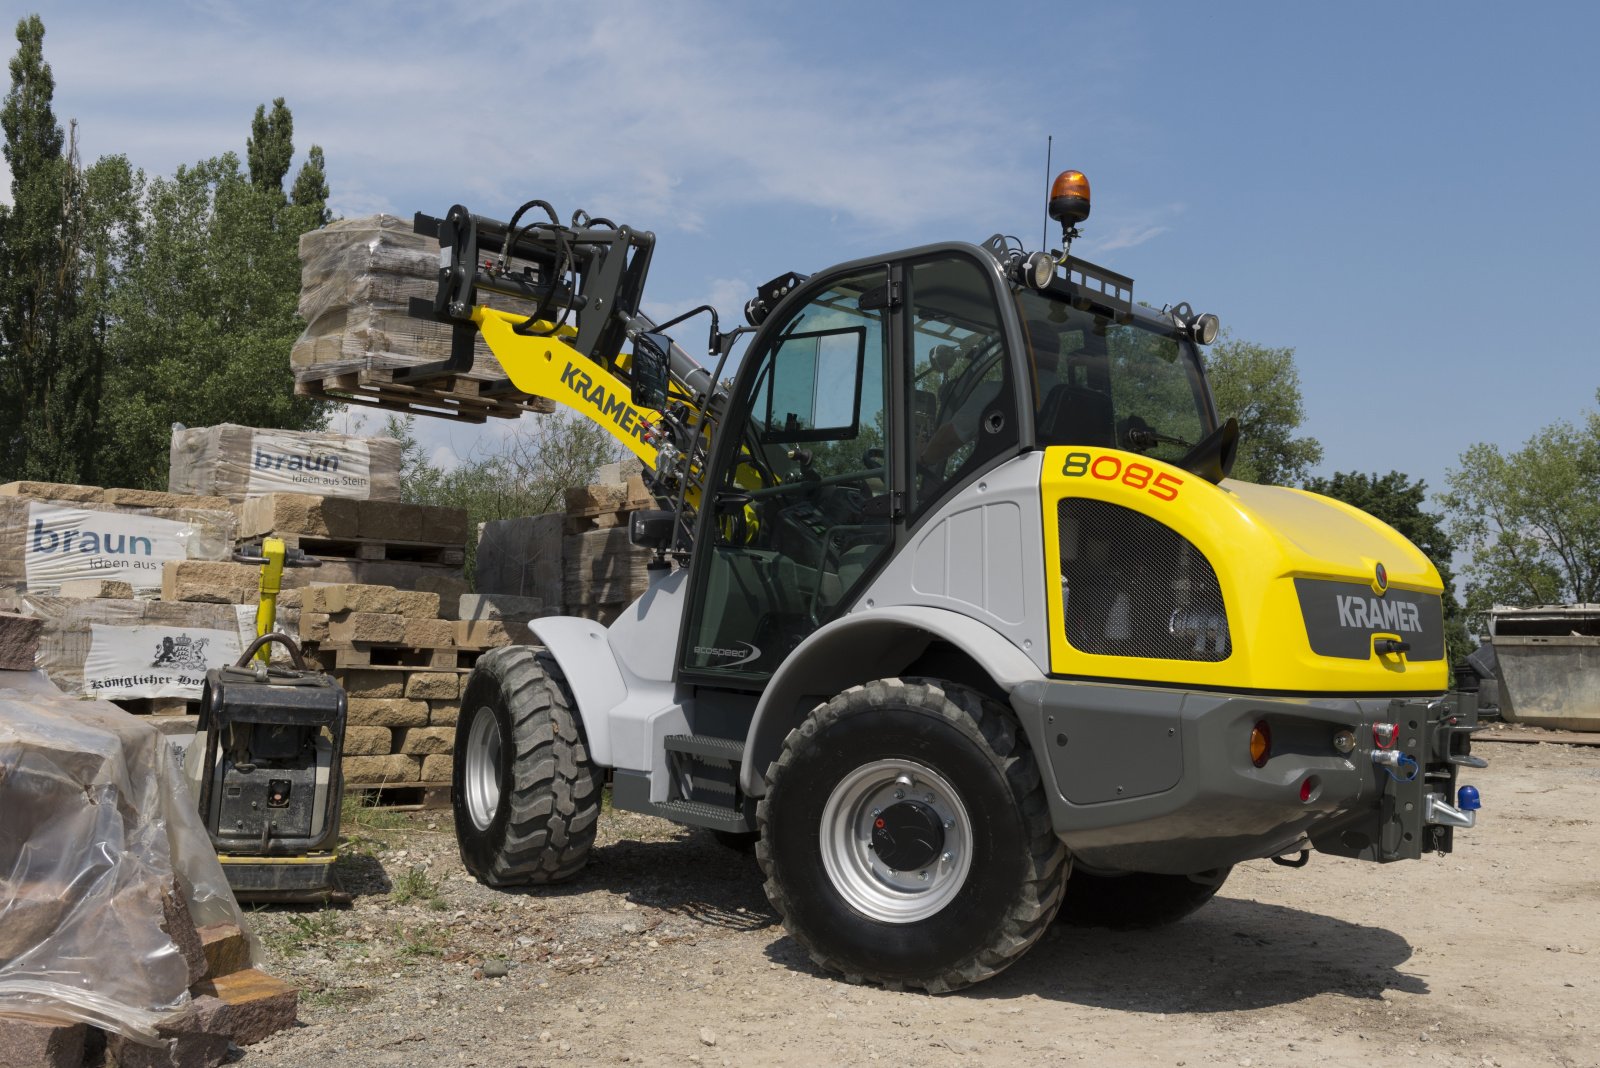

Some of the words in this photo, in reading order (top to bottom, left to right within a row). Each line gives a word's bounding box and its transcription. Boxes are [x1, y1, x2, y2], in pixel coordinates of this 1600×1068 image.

[255, 447, 339, 472] braun
[292, 474, 320, 484] Ideen
[323, 477, 340, 486] aus
[342, 476, 367, 486] Stein
[1062, 452, 1184, 502] 8085
[33, 519, 152, 556] braun
[89, 558, 129, 569] Ideen
[133, 559, 157, 570] aus
[1336, 594, 1423, 633] KRAMER
[694, 646, 746, 658] ecospeed
[91, 674, 172, 690] Königlicher
